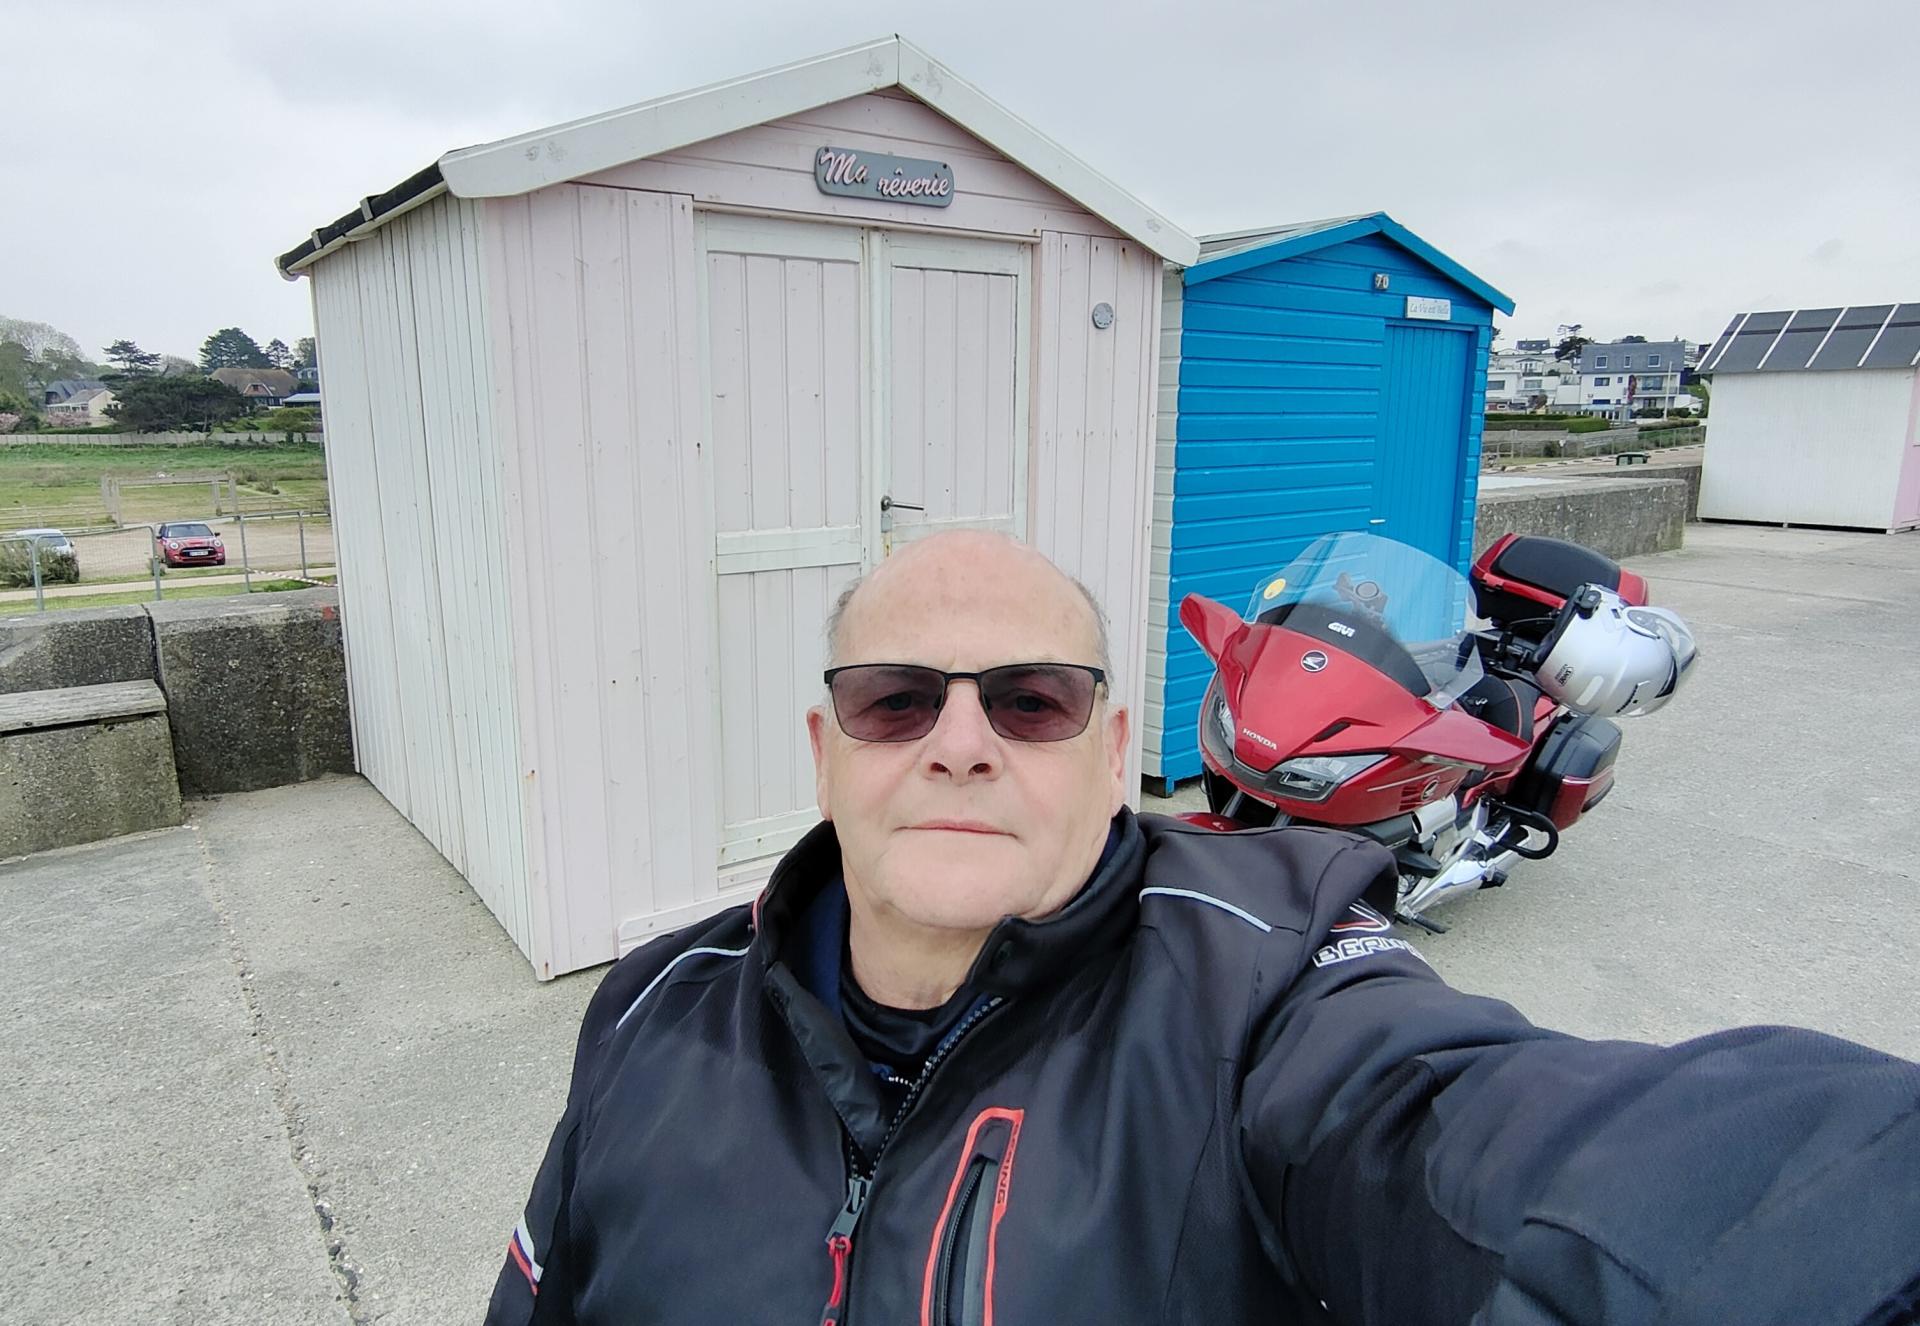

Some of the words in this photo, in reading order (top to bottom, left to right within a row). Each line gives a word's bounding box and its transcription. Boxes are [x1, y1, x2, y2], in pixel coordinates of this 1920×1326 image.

[819, 151, 869, 185] Ma
[877, 167, 950, 197] rêverie
[1242, 727, 1278, 750] HONDA
